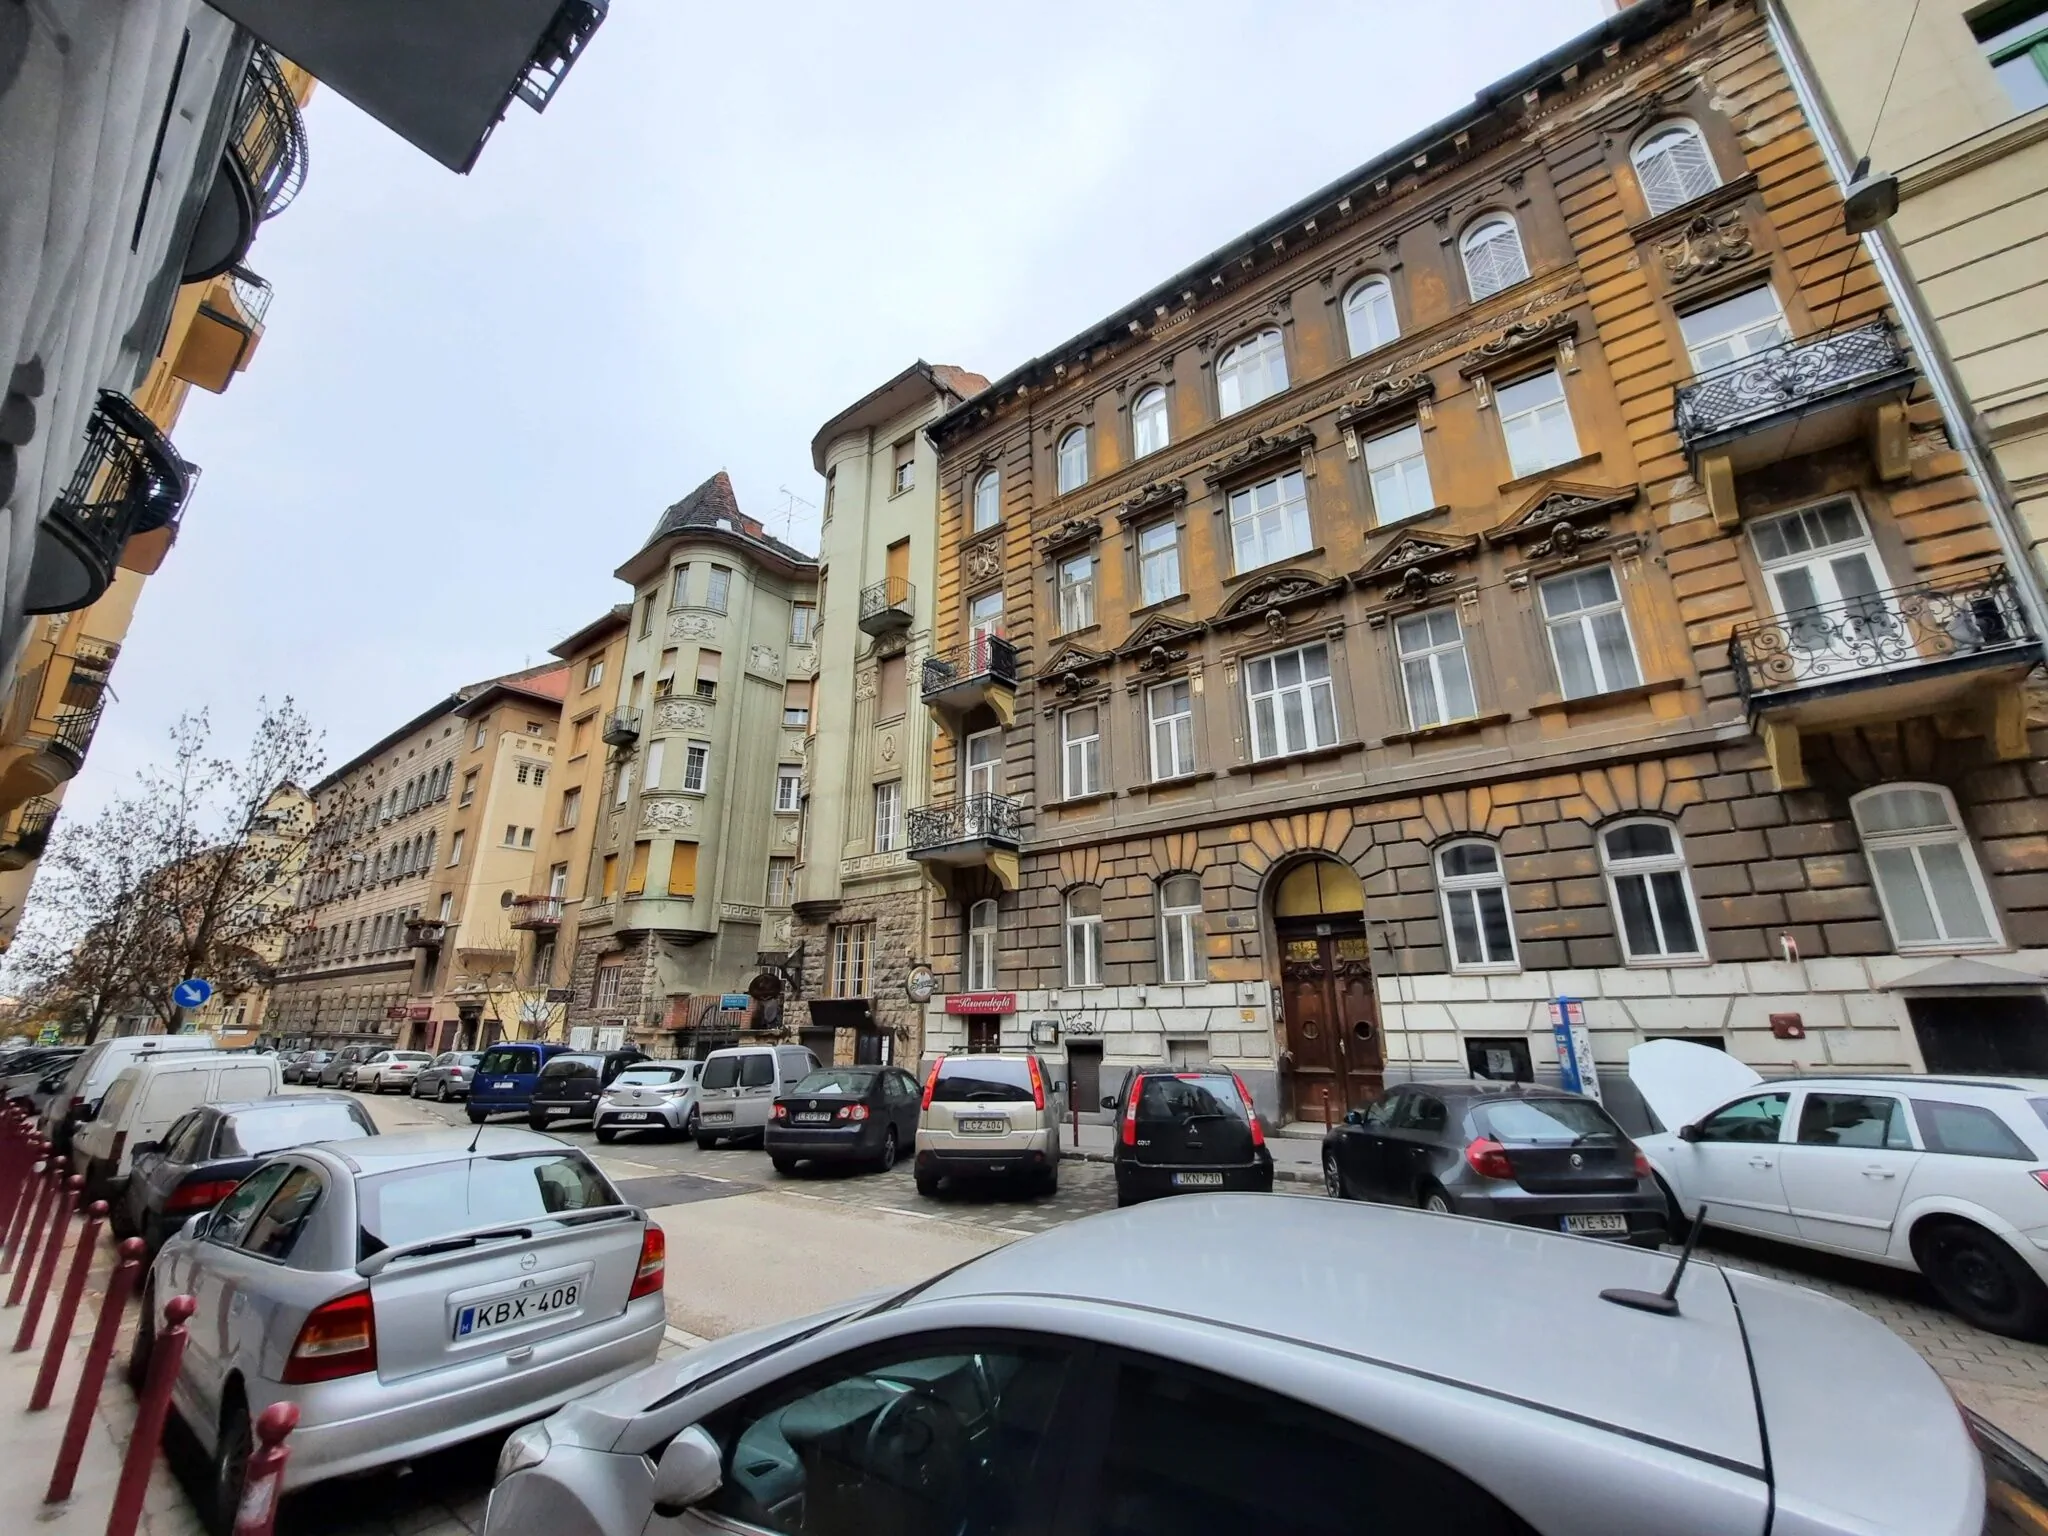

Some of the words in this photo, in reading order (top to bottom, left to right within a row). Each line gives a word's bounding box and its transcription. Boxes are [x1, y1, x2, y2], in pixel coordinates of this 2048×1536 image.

[965, 1120, 1001, 1130] LCZ-404
[1180, 1173, 1221, 1184] JKN-730
[1568, 1215, 1622, 1229] MVE-637
[477, 1286, 577, 1328] KBX-408
